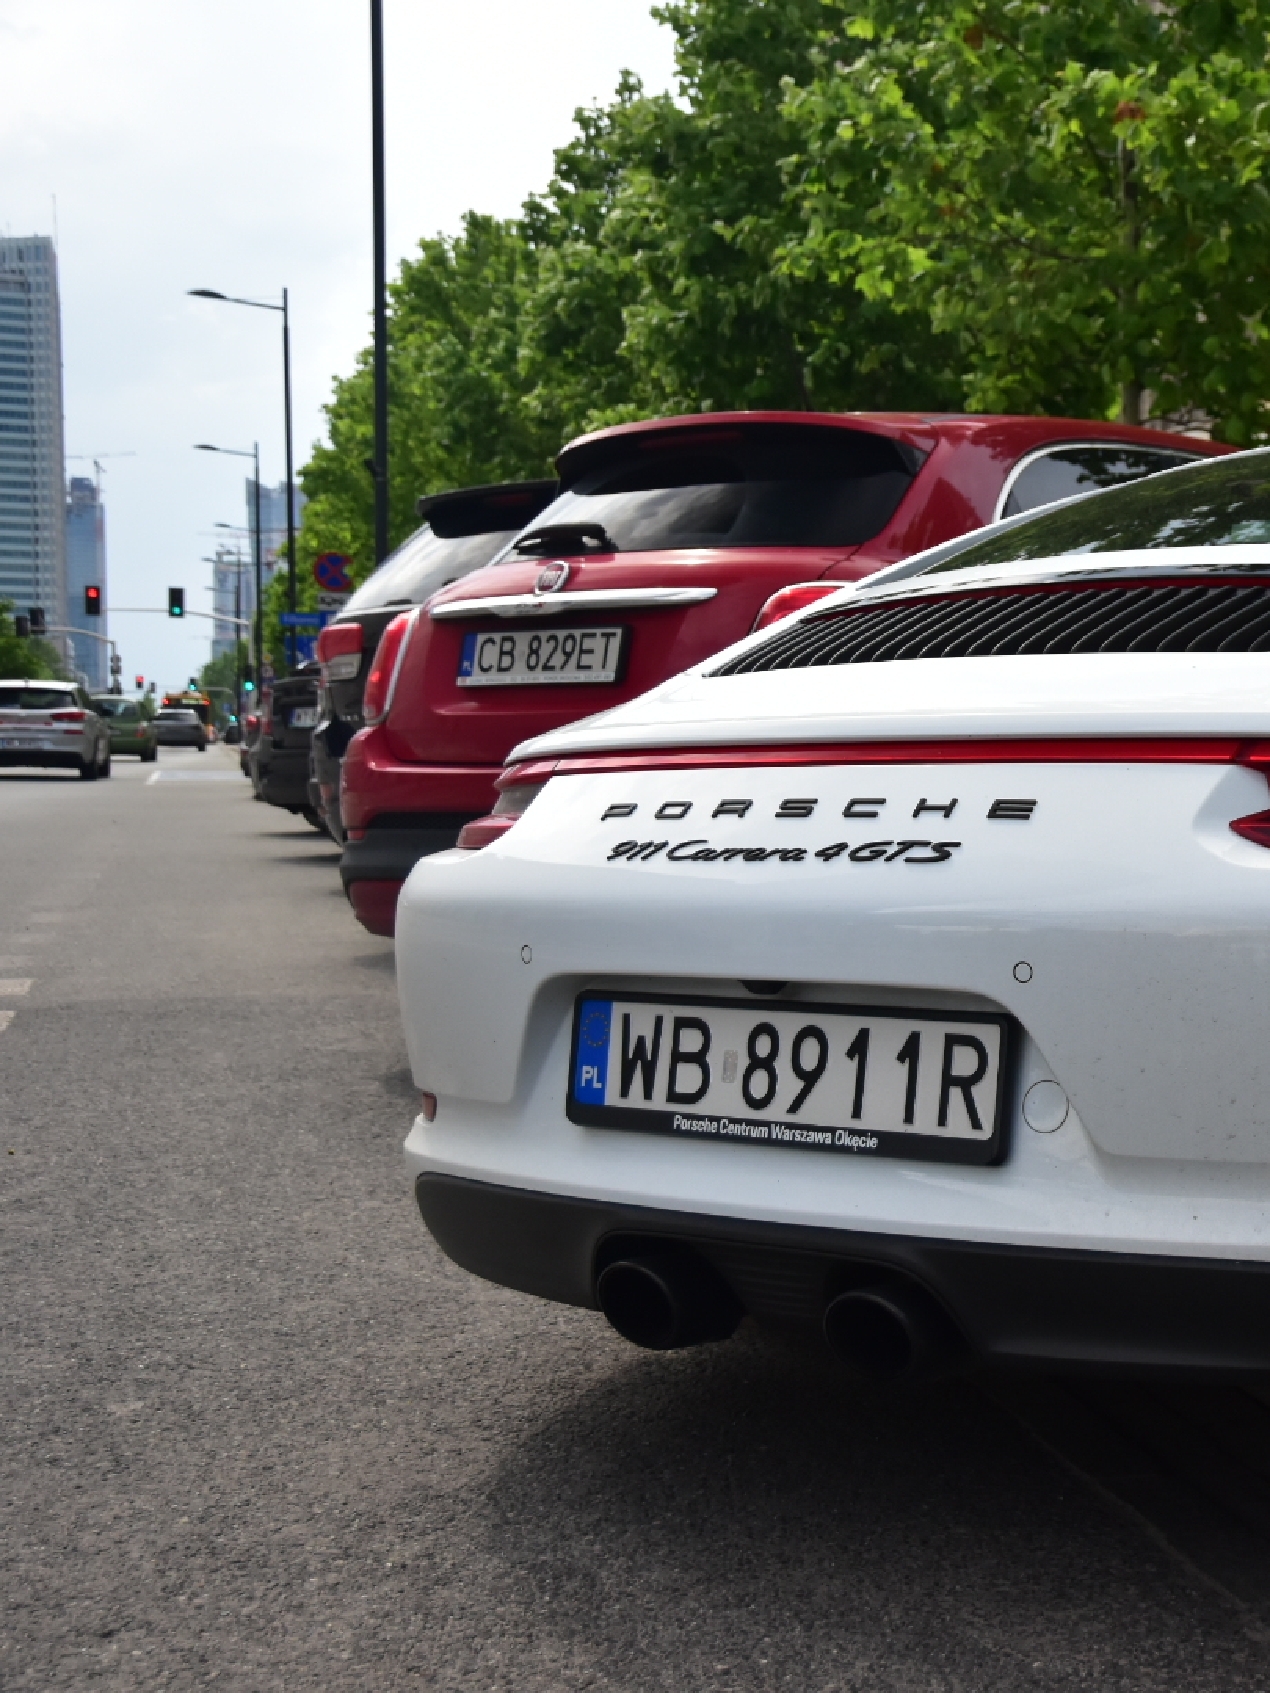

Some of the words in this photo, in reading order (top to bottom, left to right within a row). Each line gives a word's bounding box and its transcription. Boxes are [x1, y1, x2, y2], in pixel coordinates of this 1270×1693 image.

[479, 634, 516, 673] CB
[526, 632, 617, 672] 829ET
[600, 797, 1037, 821] PORSCHE
[607, 839, 668, 861] 911
[666, 839, 808, 862] Carrera
[581, 1064, 602, 1089] PL
[620, 1012, 712, 1105] WB
[742, 1021, 988, 1131] 8911R
[673, 1114, 718, 1134] Porsche
[719, 1118, 769, 1139] Centrum
[770, 1123, 832, 1145] Warszawa
[834, 1129, 879, 1151] Okęcie
